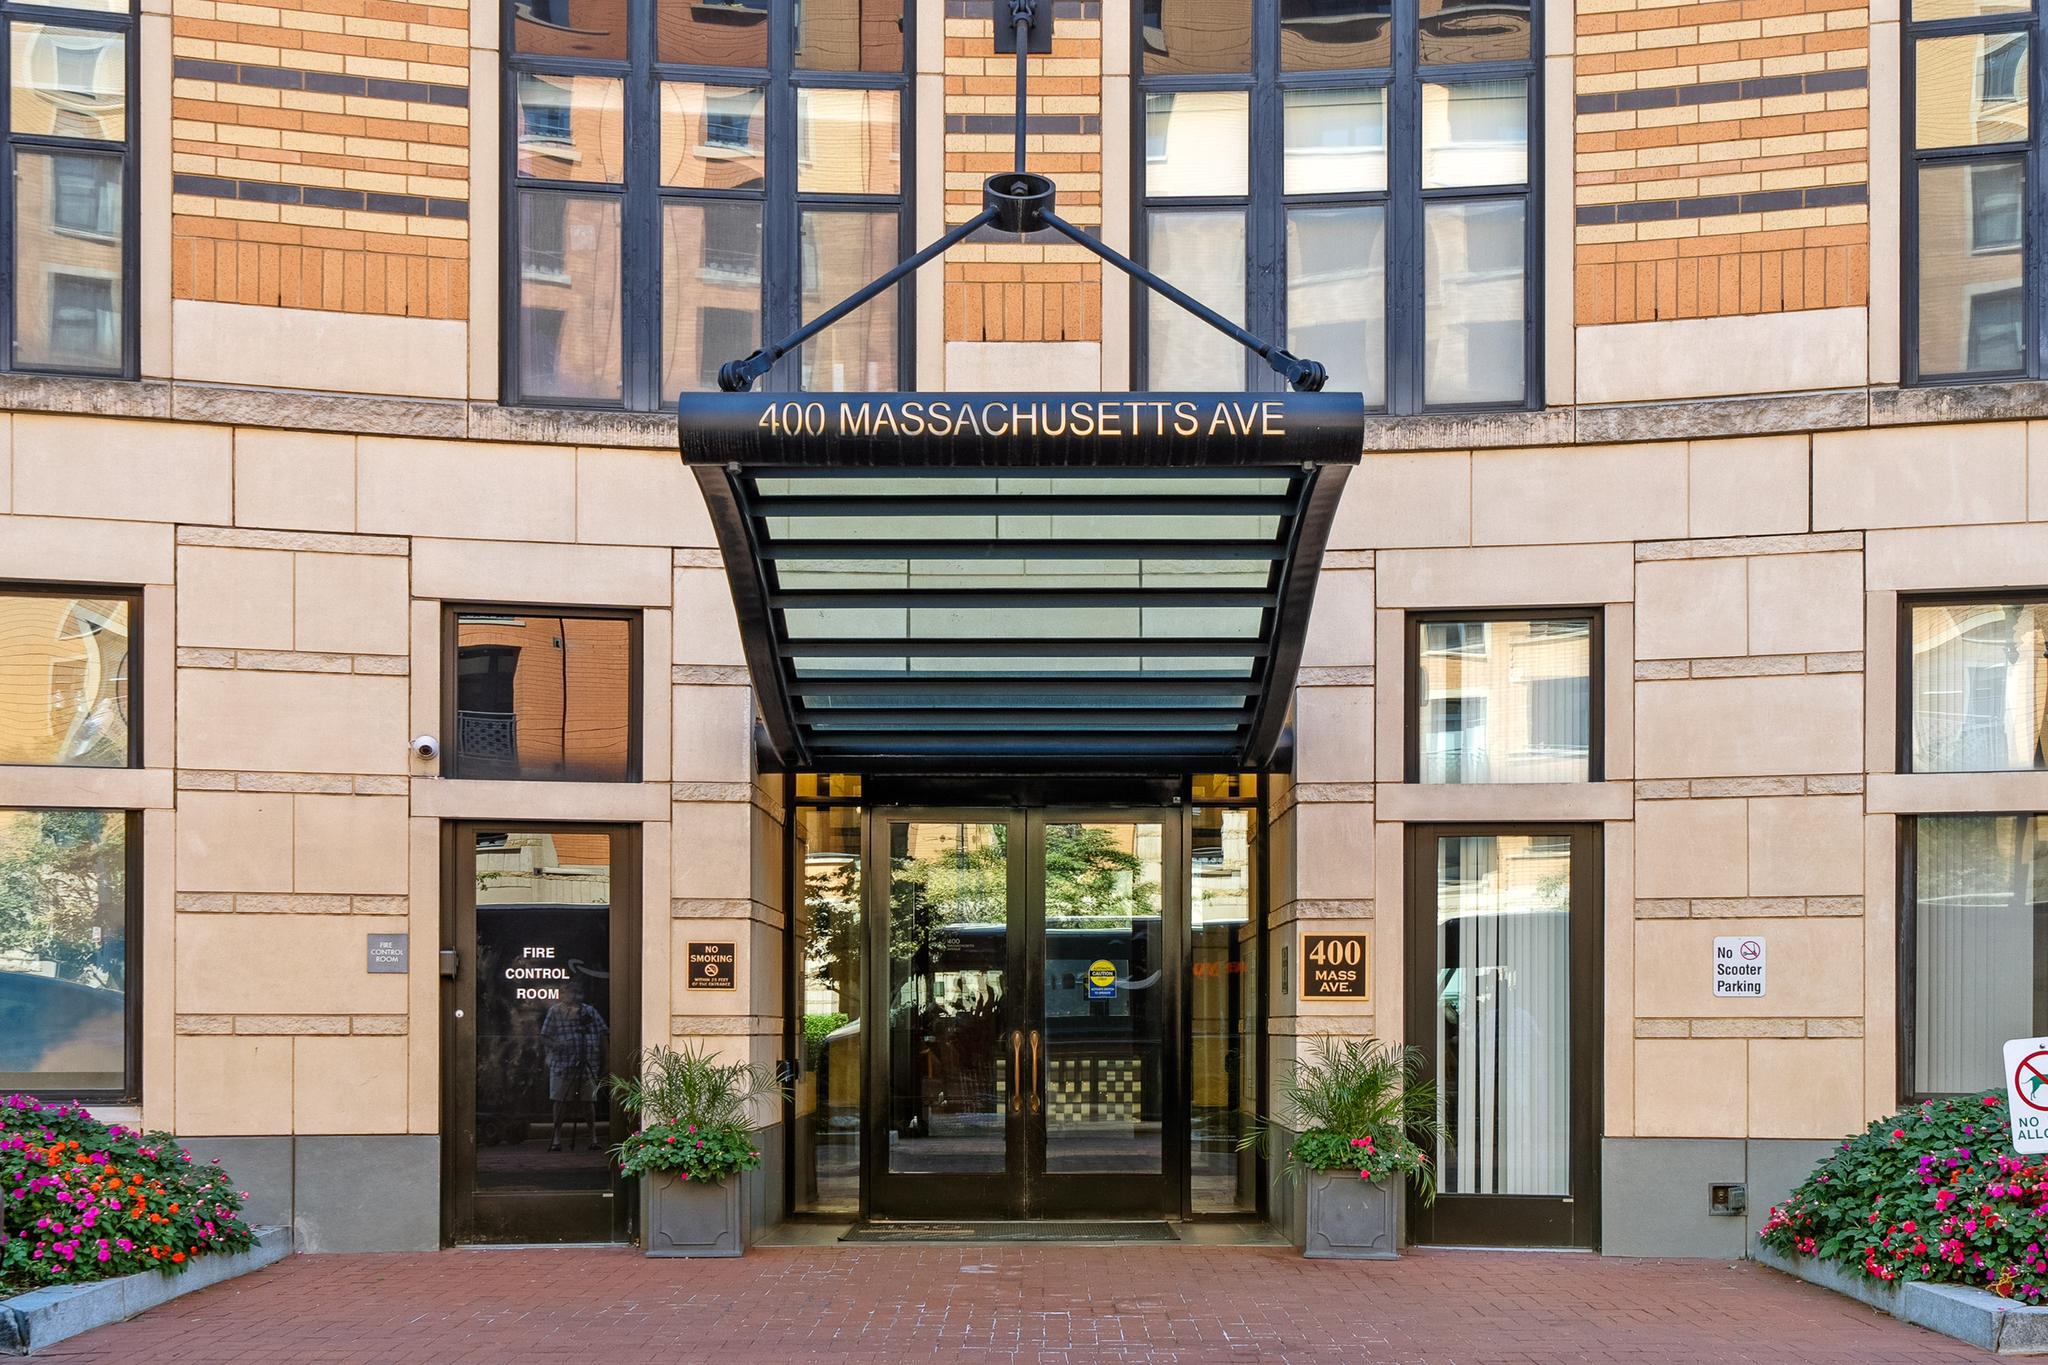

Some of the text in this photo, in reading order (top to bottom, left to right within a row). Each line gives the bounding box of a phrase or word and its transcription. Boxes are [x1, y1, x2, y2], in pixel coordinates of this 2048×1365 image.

[758, 402, 1286, 436] 400 MASSACHUSETTS AVE
[379, 941, 393, 949] FIRE
[705, 945, 719, 954] NO
[370, 948, 404, 956] CONTROL
[523, 947, 555, 959] FIRE
[1309, 940, 1361, 966] 400
[1717, 946, 1733, 959] No
[375, 955, 399, 963] ROOM
[690, 954, 733, 963] SMOKING
[505, 968, 570, 980] CONTROL
[1315, 970, 1357, 981] MASS
[1717, 963, 1762, 976] Scooter
[1319, 982, 1353, 992] AVE.
[1717, 980, 1761, 995] Parking
[516, 988, 560, 1000] ROOM
[2018, 1116, 2039, 1128] NO
